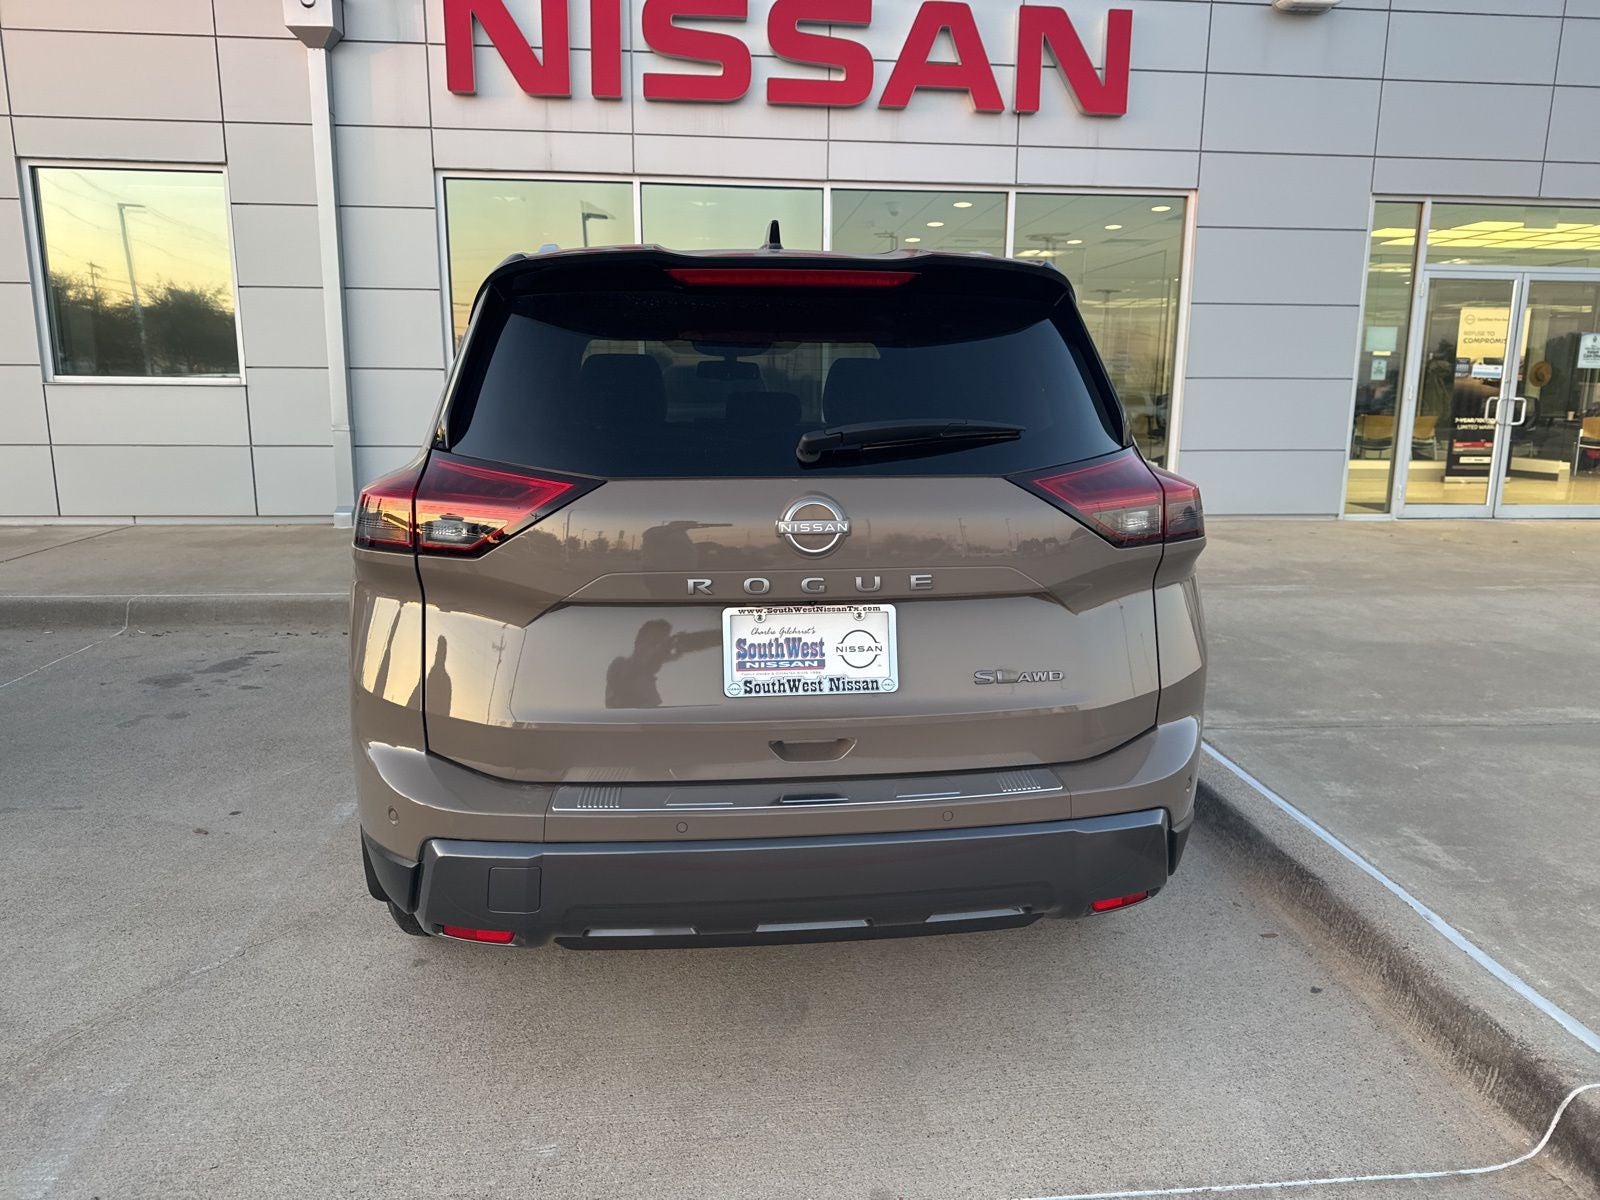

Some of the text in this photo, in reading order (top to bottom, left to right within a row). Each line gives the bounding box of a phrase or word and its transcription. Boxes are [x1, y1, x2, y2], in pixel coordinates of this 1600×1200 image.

[443, 0, 1133, 117] NISSAN
[779, 521, 849, 535] NISSAN
[686, 573, 934, 596] ROGUE
[735, 636, 826, 661] SouthWest
[835, 645, 883, 653] NISSAN
[745, 660, 819, 669] NISSAN
[1017, 671, 1065, 682] AWD
[743, 677, 880, 695] SouthWest Nissan
